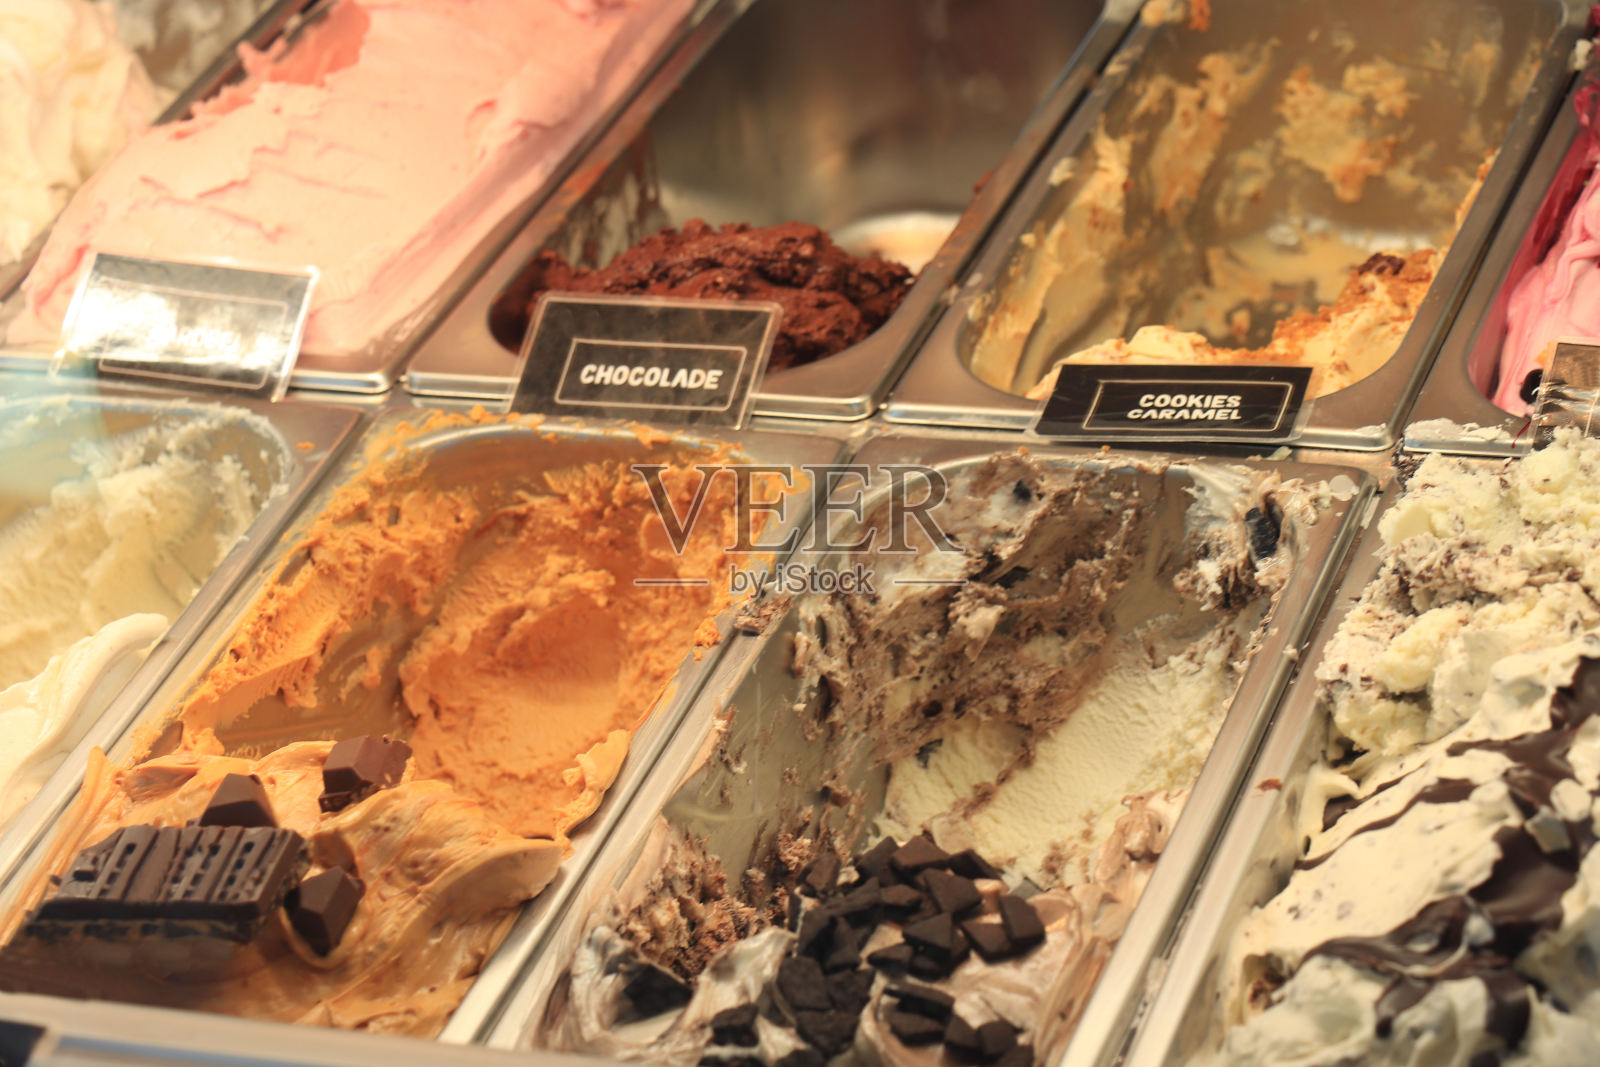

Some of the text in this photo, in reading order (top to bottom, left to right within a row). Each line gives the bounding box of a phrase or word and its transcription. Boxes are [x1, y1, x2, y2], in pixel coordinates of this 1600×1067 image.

[580, 364, 723, 390] CHOCOLADE
[1139, 393, 1242, 409] COOKIES
[1127, 408, 1242, 421] CARAMEL
